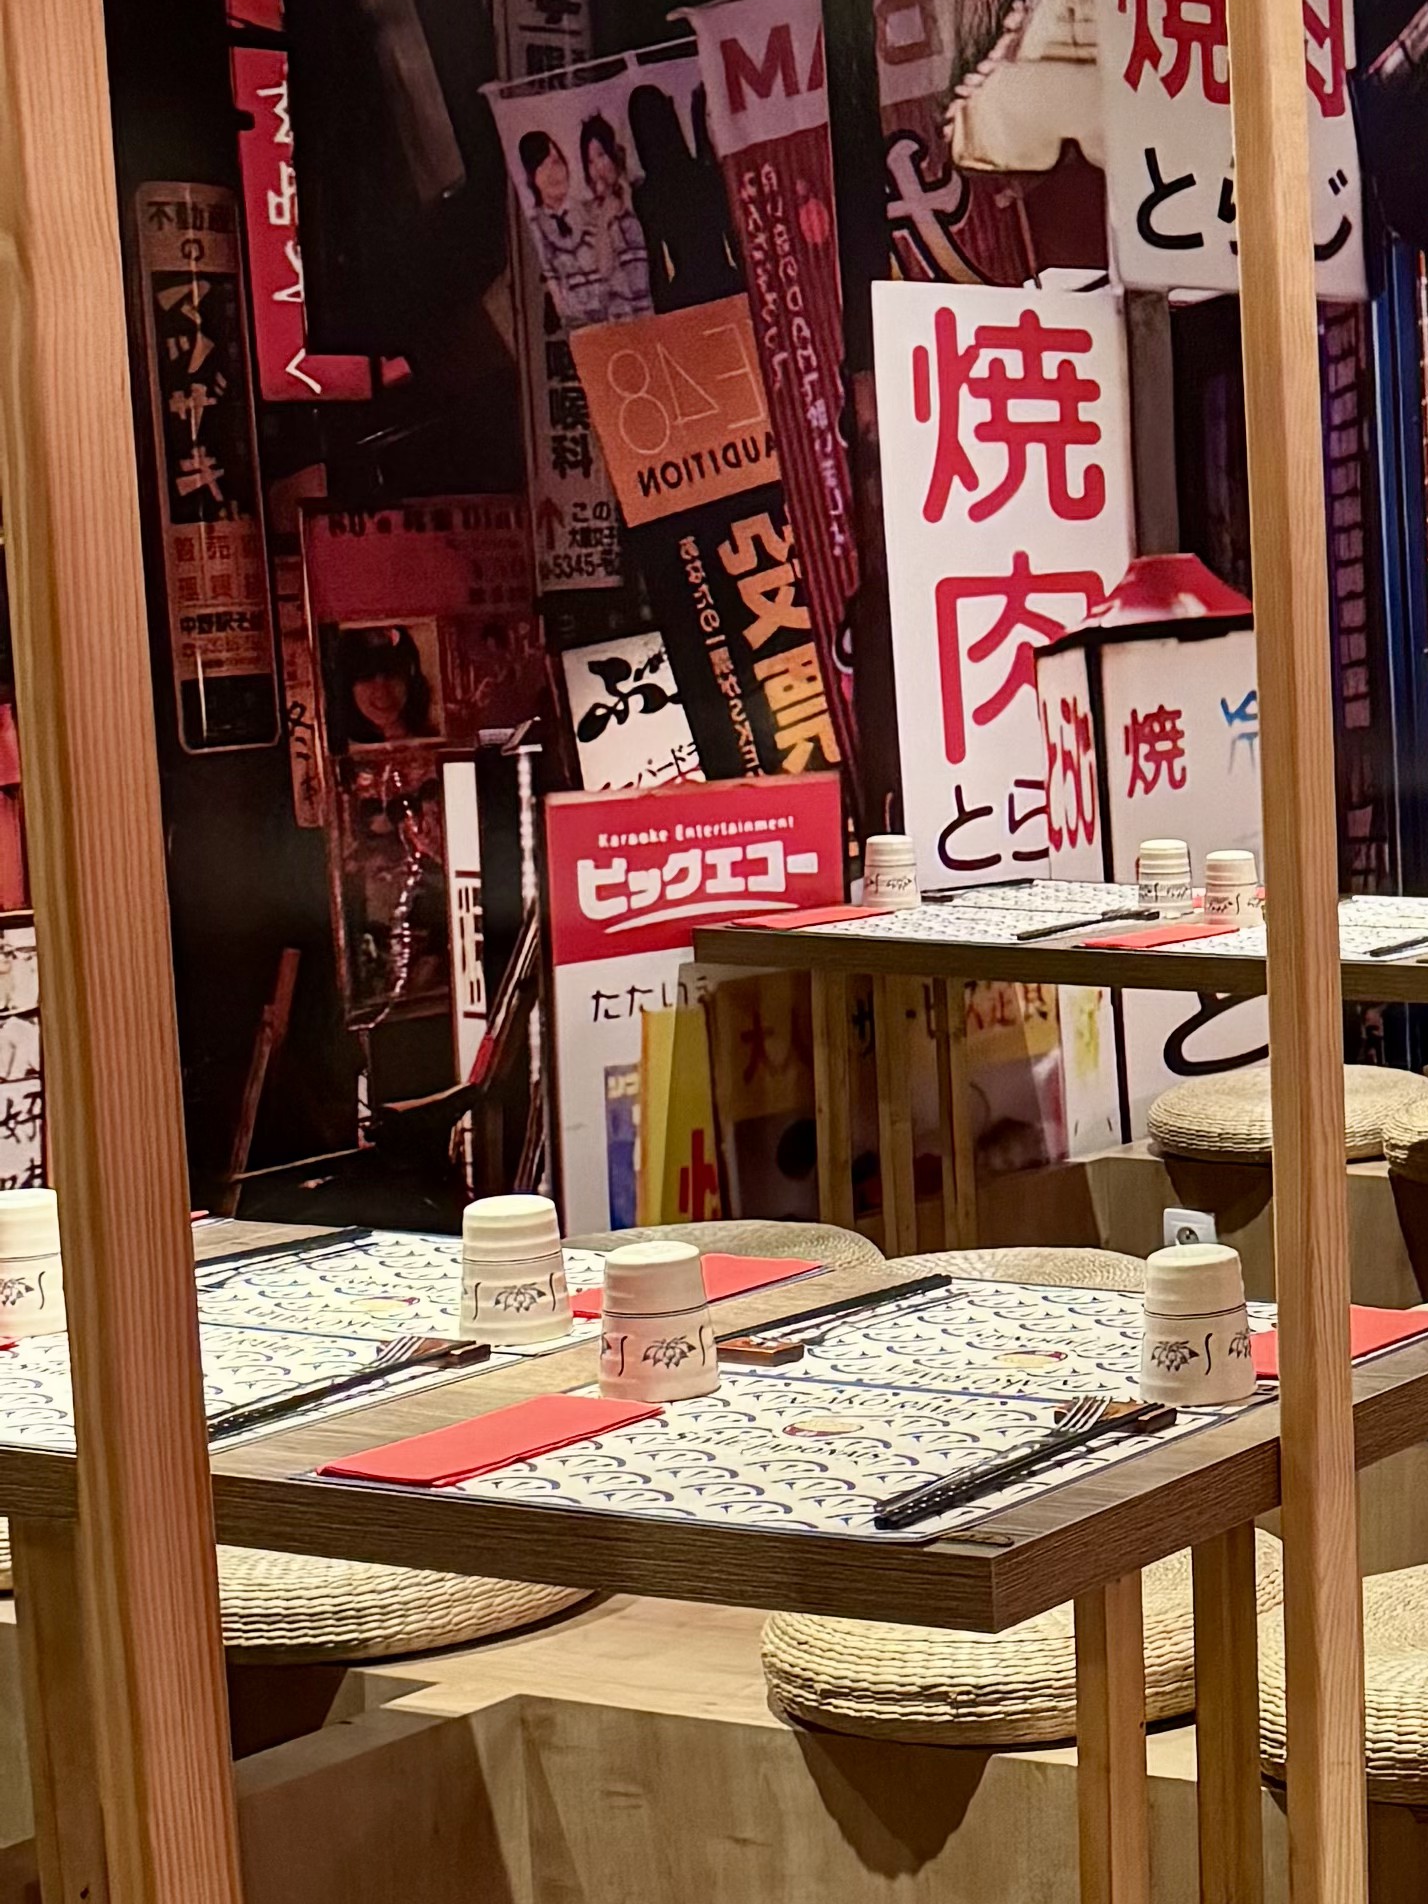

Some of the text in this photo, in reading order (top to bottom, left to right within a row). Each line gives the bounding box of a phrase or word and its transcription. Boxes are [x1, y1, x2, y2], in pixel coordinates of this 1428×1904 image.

[1140, 146, 1351, 261] とじ
[912, 306, 1106, 765] 焼肉
[1124, 704, 1187, 799] 焼
[598, 815, 795, 848] Karaoke Entertainment
[577, 840, 818, 921] ビッグエコー
